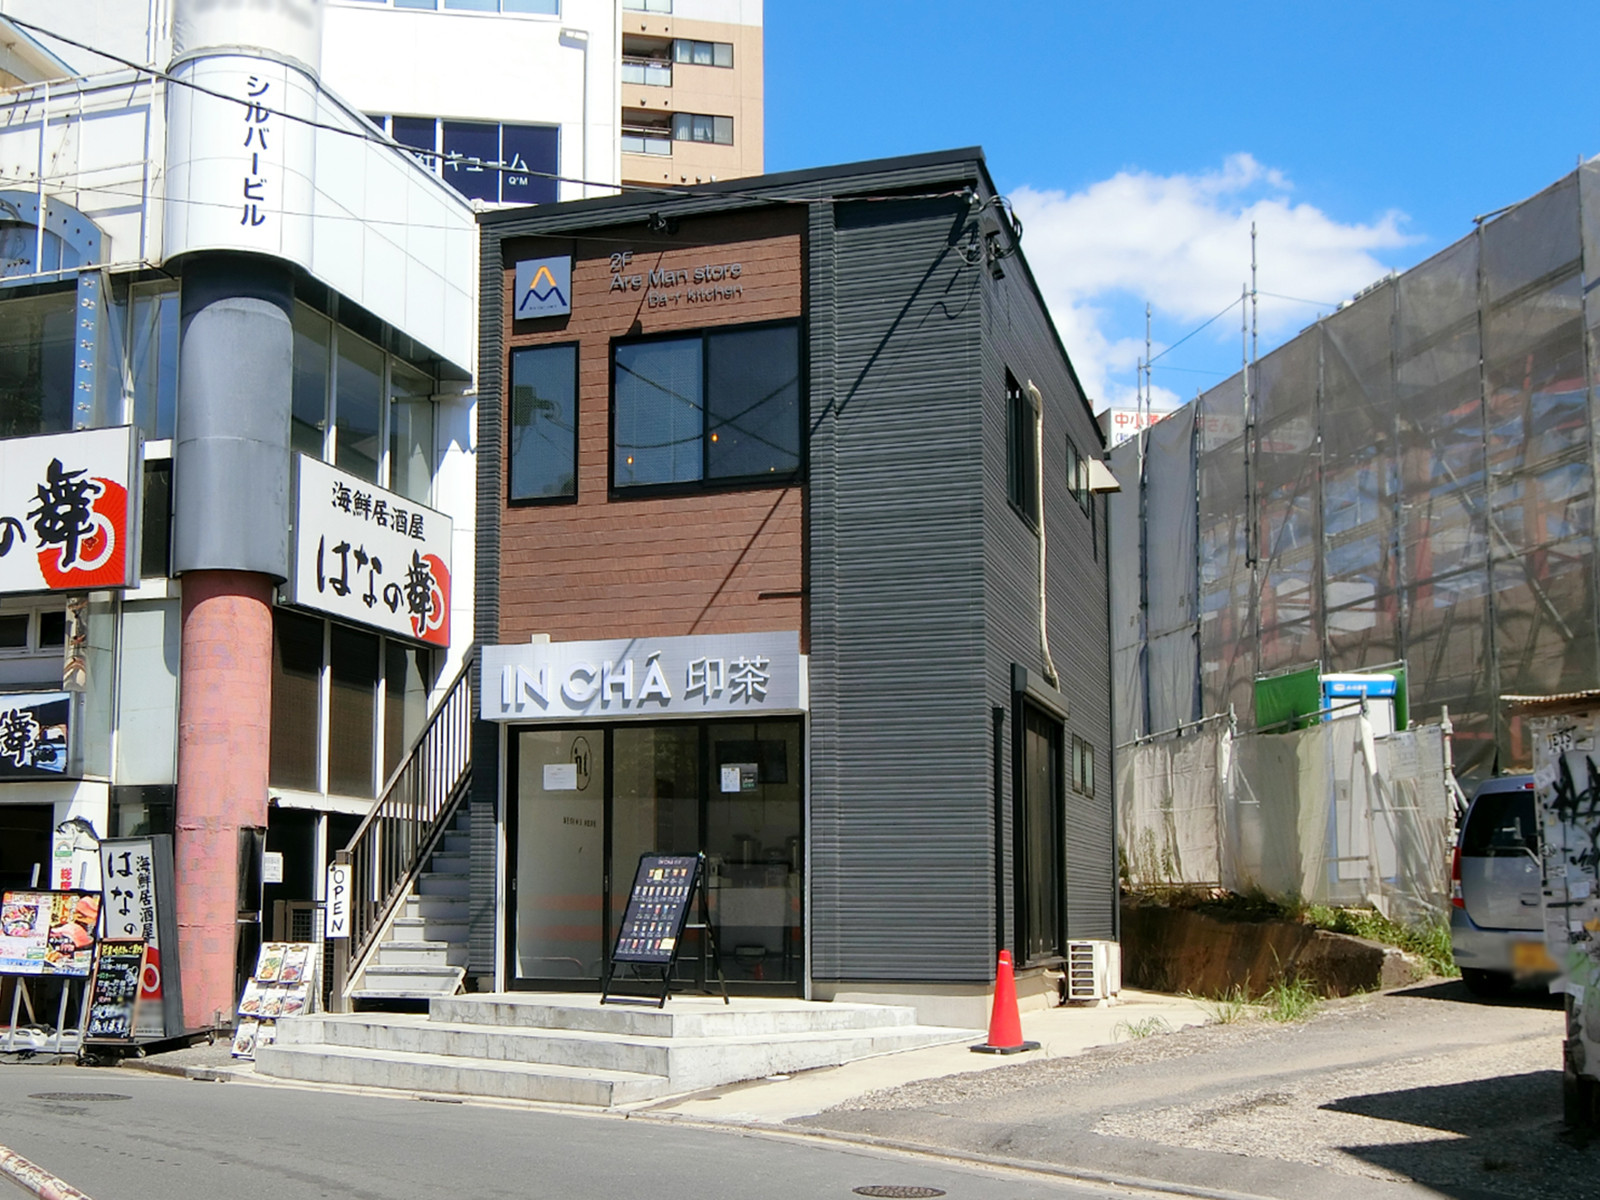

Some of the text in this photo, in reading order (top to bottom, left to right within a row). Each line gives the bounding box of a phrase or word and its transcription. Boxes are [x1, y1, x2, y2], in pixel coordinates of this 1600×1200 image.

[240, 76, 271, 228] シルバービル
[609, 262, 742, 291] Are Man store
[610, 251, 634, 268] 2F
[687, 283, 743, 302] kitchen
[331, 480, 427, 542] 海鮮居酒屋
[317, 534, 437, 637] はなの舞
[688, 655, 771, 697] 印茶
[107, 851, 138, 936] はなの
[136, 855, 156, 941] 海鮮居酒屋
[331, 870, 345, 933] OPEN
